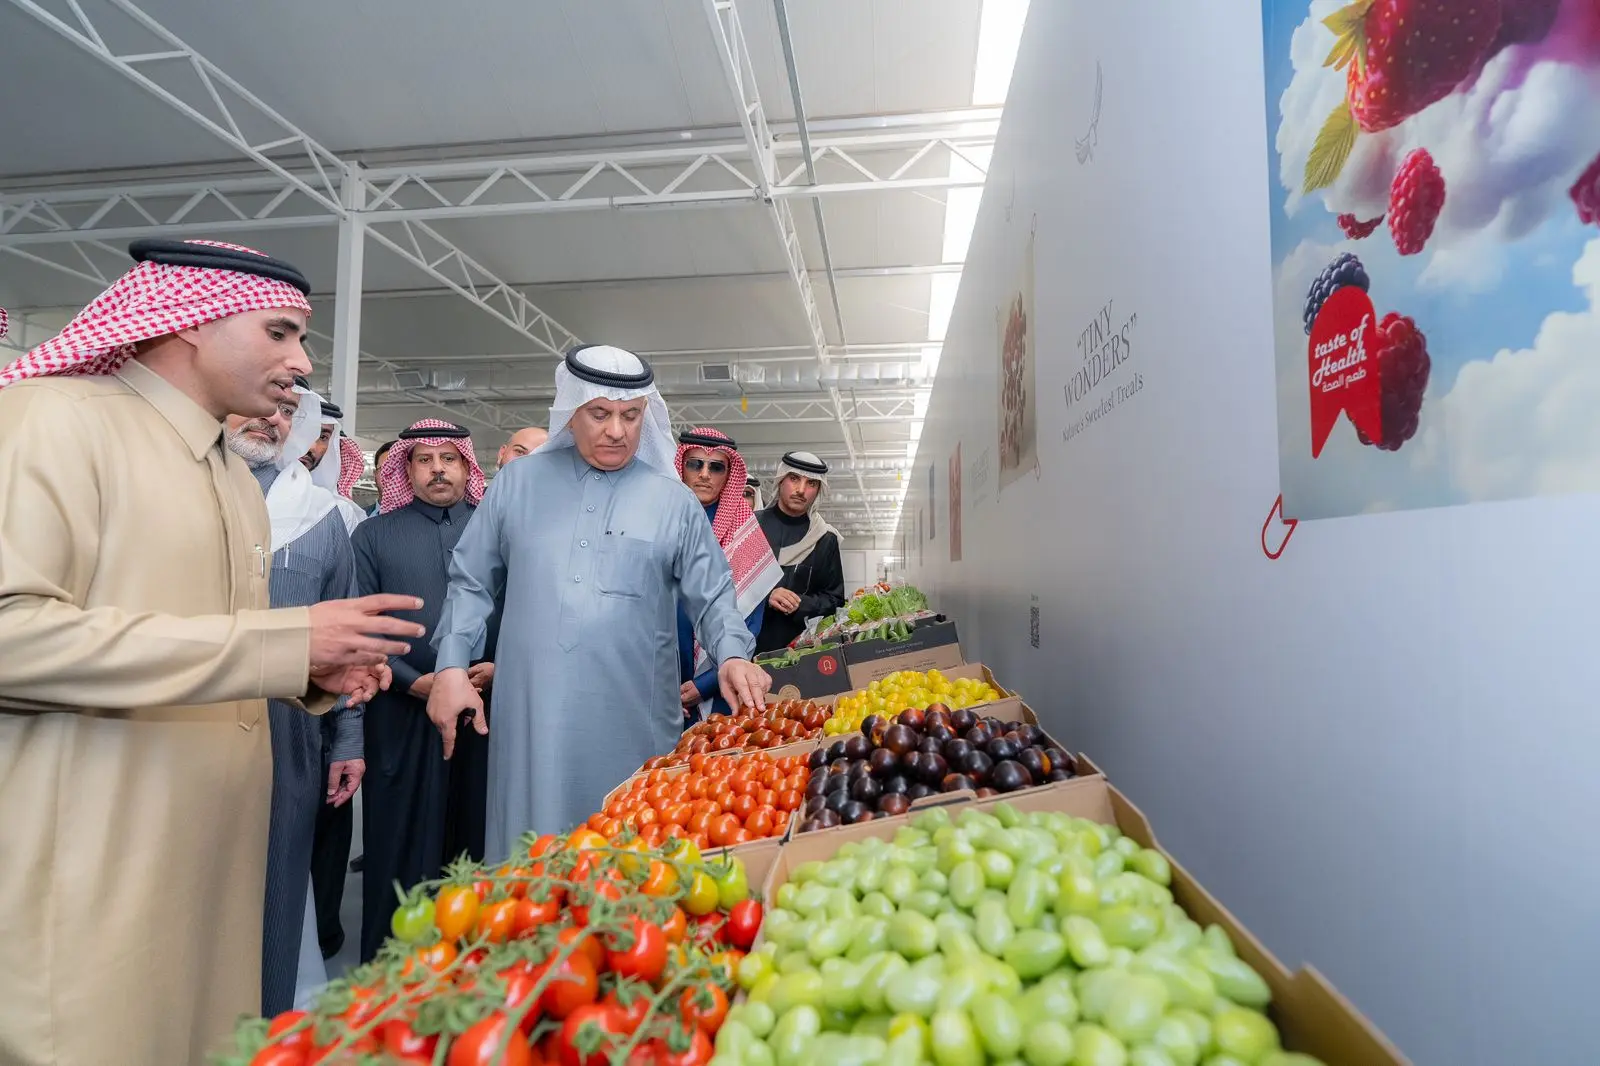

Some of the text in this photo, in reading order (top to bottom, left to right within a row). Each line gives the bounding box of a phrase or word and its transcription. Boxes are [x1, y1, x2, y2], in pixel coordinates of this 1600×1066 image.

[1314, 313, 1370, 359] taste of
[1312, 345, 1368, 387] Health
